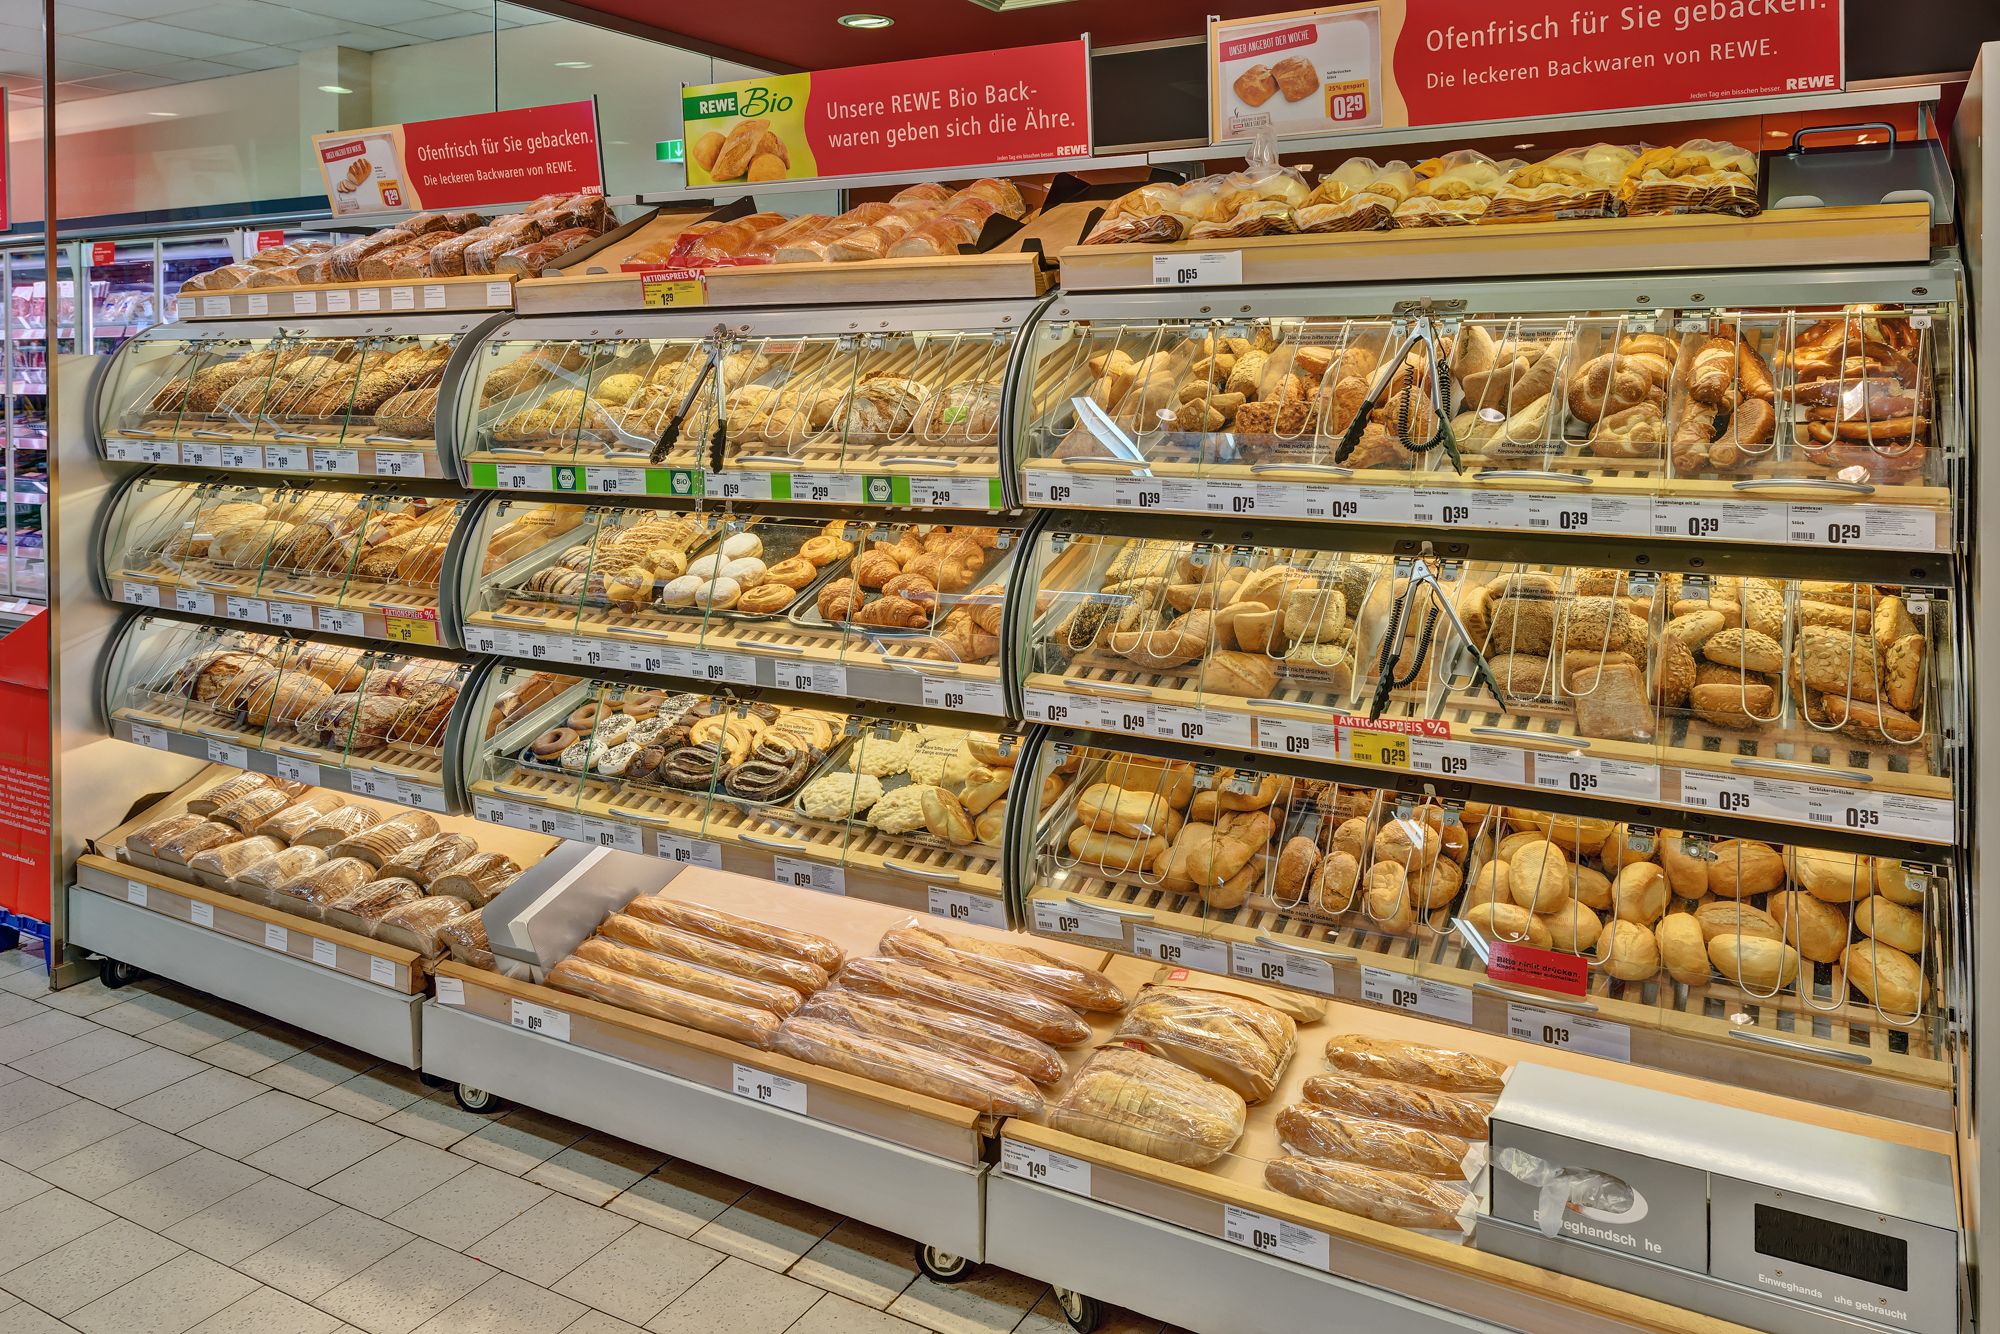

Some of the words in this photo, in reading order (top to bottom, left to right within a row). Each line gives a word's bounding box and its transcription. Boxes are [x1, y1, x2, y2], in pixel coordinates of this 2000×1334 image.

[1427, 15, 1558, 52] Ofenfrisch
[1571, 11, 1609, 36] für
[1621, 6, 1661, 31] Sie
[1228, 42, 1249, 57] UNSER
[1248, 37, 1275, 53] ANGEBOT
[1275, 34, 1288, 48] DER
[1288, 28, 1310, 43] WOCHE
[1427, 72, 1455, 89] Die
[1462, 66, 1539, 86] leckeren
[1548, 53, 1655, 77] Backwaren
[1664, 49, 1700, 65] von
[1710, 38, 1778, 61] REWE.
[1343, 82, 1365, 91] gespart
[1786, 74, 1835, 90] REWE
[827, 98, 884, 120] Unsere
[891, 90, 941, 114] REWE
[950, 87, 978, 109] Bio
[985, 80, 1038, 105] Back-
[1690, 91, 1708, 100] Jeden
[1708, 90, 1720, 99] Tag
[1720, 89, 1731, 97] ein
[1732, 87, 1759, 96] bisschen
[1760, 85, 1781, 94] besser.
[699, 97, 737, 115] REWE
[740, 87, 793, 118] Bio
[828, 130, 879, 148] waren
[887, 121, 940, 148] geben
[946, 117, 981, 139] sich
[989, 114, 1017, 134] die
[1024, 107, 1076, 130] Ähre.
[417, 139, 478, 162] Ofenfrisch
[481, 137, 499, 156] für
[503, 135, 522, 152] Sie
[527, 130, 593, 155] gebacken.
[1056, 144, 1087, 156] REWE
[424, 174, 438, 186] Die
[439, 169, 474, 185] leckeren
[477, 165, 525, 182] Backwaren
[527, 165, 544, 177] von
[546, 160, 577, 174] REWE.
[582, 185, 602, 195] REWE
[642, 271, 689, 283] AKTIONSPREIS
[1177, 268, 1198, 284] 0.65
[661, 292, 674, 306] 1.29
[513, 475, 526, 488] 0.79
[603, 479, 617, 492] 0.69
[723, 483, 739, 497] 0.59
[812, 486, 829, 501] 2.99
[932, 490, 950, 506] 2.49
[1050, 485, 1070, 501] 0.29
[1138, 491, 1160, 508] 0.39
[1232, 496, 1255, 513] 0.75
[1332, 501, 1357, 518] 0.49
[1442, 506, 1469, 524] 0.39
[1560, 511, 1588, 530] 0.39
[1688, 517, 1719, 537] 0.39
[1828, 523, 1861, 544] 0.29
[480, 639, 494, 652] 0.99
[532, 645, 546, 658] 0.99
[587, 651, 600, 664] 1.79
[645, 658, 661, 672] 0.49
[707, 665, 724, 679] 0.89
[795, 675, 812, 690] 0.79
[944, 692, 964, 708] 0.39
[1047, 705, 1068, 721] 0.29
[1123, 714, 1145, 731] 0.49
[1181, 722, 1203, 739] 0.20
[1427, 721, 1447, 735] %
[1286, 736, 1310, 753] 0.39
[1381, 748, 1406, 766] 0.29
[1441, 756, 1467, 774] 0.29
[1569, 772, 1598, 791] 0.35
[1719, 791, 1750, 811] 0.35
[490, 809, 504, 823] 0.59
[1846, 808, 1879, 828] 0.35
[541, 820, 555, 833] 0.69
[600, 832, 614, 846] 0.79
[675, 848, 691, 862] 0.99
[794, 872, 811, 887] 0.99
[950, 903, 969, 919] 0.49
[1059, 916, 1079, 932] 0.29
[1159, 943, 1181, 961] 0.29
[1261, 962, 1284, 980] 0.29
[1542, 965, 1581, 978] drücken.
[1392, 988, 1418, 1007] 0.29
[528, 1015, 542, 1030] 0.69
[1543, 1025, 1570, 1046] 0.13
[756, 1084, 772, 1100] 1.19
[1026, 1161, 1047, 1179] 1.49
[1253, 1229, 1277, 1250] 0.95
[1855, 1298, 1908, 1321] gebraucht
